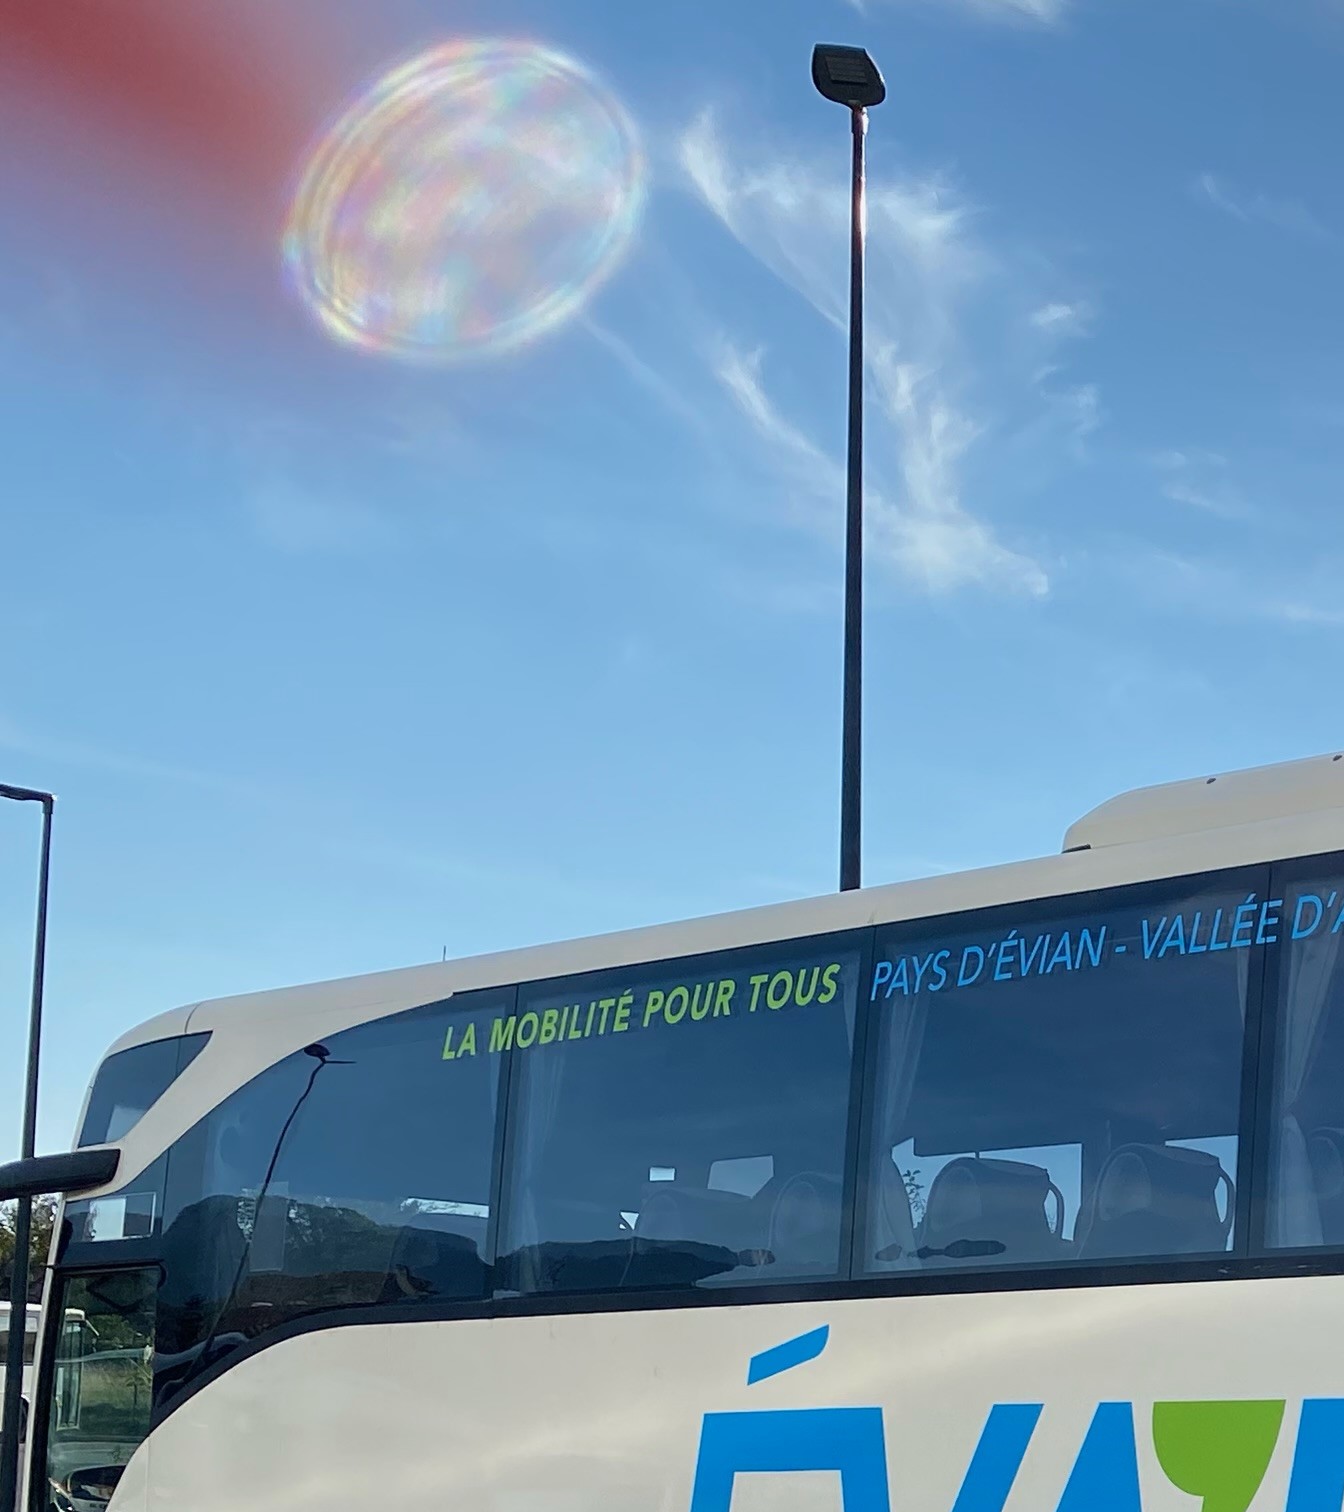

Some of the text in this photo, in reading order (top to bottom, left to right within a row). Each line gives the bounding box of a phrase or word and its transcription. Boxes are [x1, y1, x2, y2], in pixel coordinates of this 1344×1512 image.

[442, 1023, 476, 1059] LA
[489, 988, 633, 1053] MOBILITÉ
[643, 979, 736, 1027] POUR
[750, 963, 841, 1012] TOUS
[870, 948, 951, 1001] PAYS
[957, 926, 1107, 988] D'ÉVIAN
[1141, 895, 1283, 960] VALLÉE
